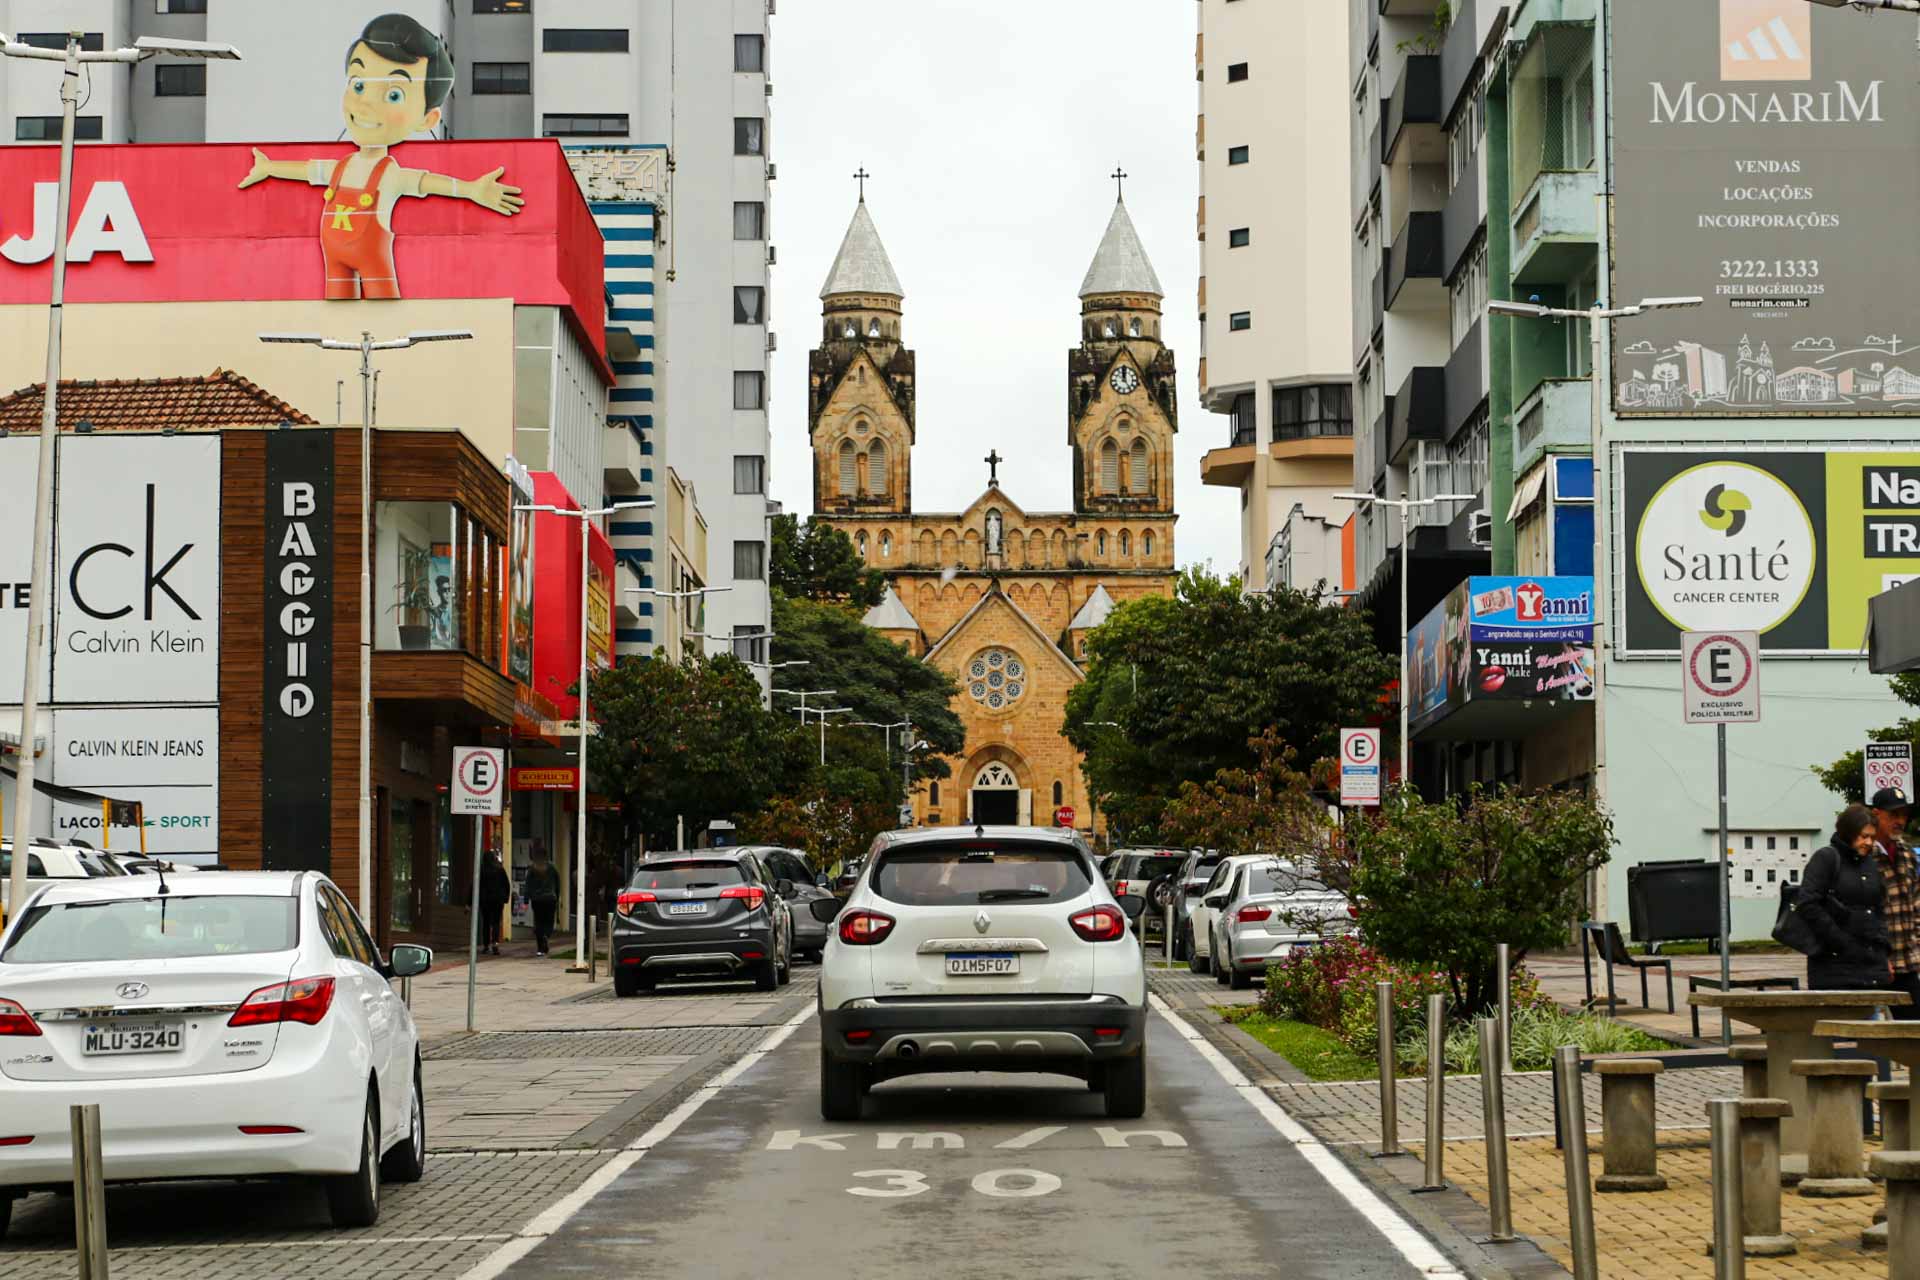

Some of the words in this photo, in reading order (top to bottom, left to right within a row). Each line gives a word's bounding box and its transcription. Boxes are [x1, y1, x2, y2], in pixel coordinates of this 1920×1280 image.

[1735, 160, 1800, 174] VENDAS
[1723, 184, 1813, 202] LOCAÇÕES
[0, 181, 155, 264] JA
[331, 204, 356, 232] K
[1698, 211, 1840, 230] INCORPORAÇÕES
[1719, 259, 1819, 278] 3222.1333
[1716, 284, 1744, 295] FREI
[1730, 299, 1808, 308] monarim.com.br
[1869, 523, 1920, 553] TR
[1663, 539, 1790, 582] Santé
[279, 481, 317, 718] BAGGIO
[1517, 590, 1588, 617] Yanni
[1673, 592, 1726, 604] CANCER
[1729, 592, 1780, 604] CENTER
[68, 630, 140, 654] Calvin
[150, 629, 205, 653] Klein
[1476, 648, 1532, 665] Yanni
[1710, 648, 1733, 684] E
[1506, 666, 1531, 678] Make
[1700, 701, 1744, 709] EXCLUSIVO
[68, 740, 117, 757] CALVIN
[121, 740, 158, 756] KLEIN
[162, 739, 204, 756] JEANS
[1354, 739, 1366, 757] E
[473, 760, 489, 786] E
[160, 816, 212, 828] SPORT
[845, 1168, 1062, 1197] 30
